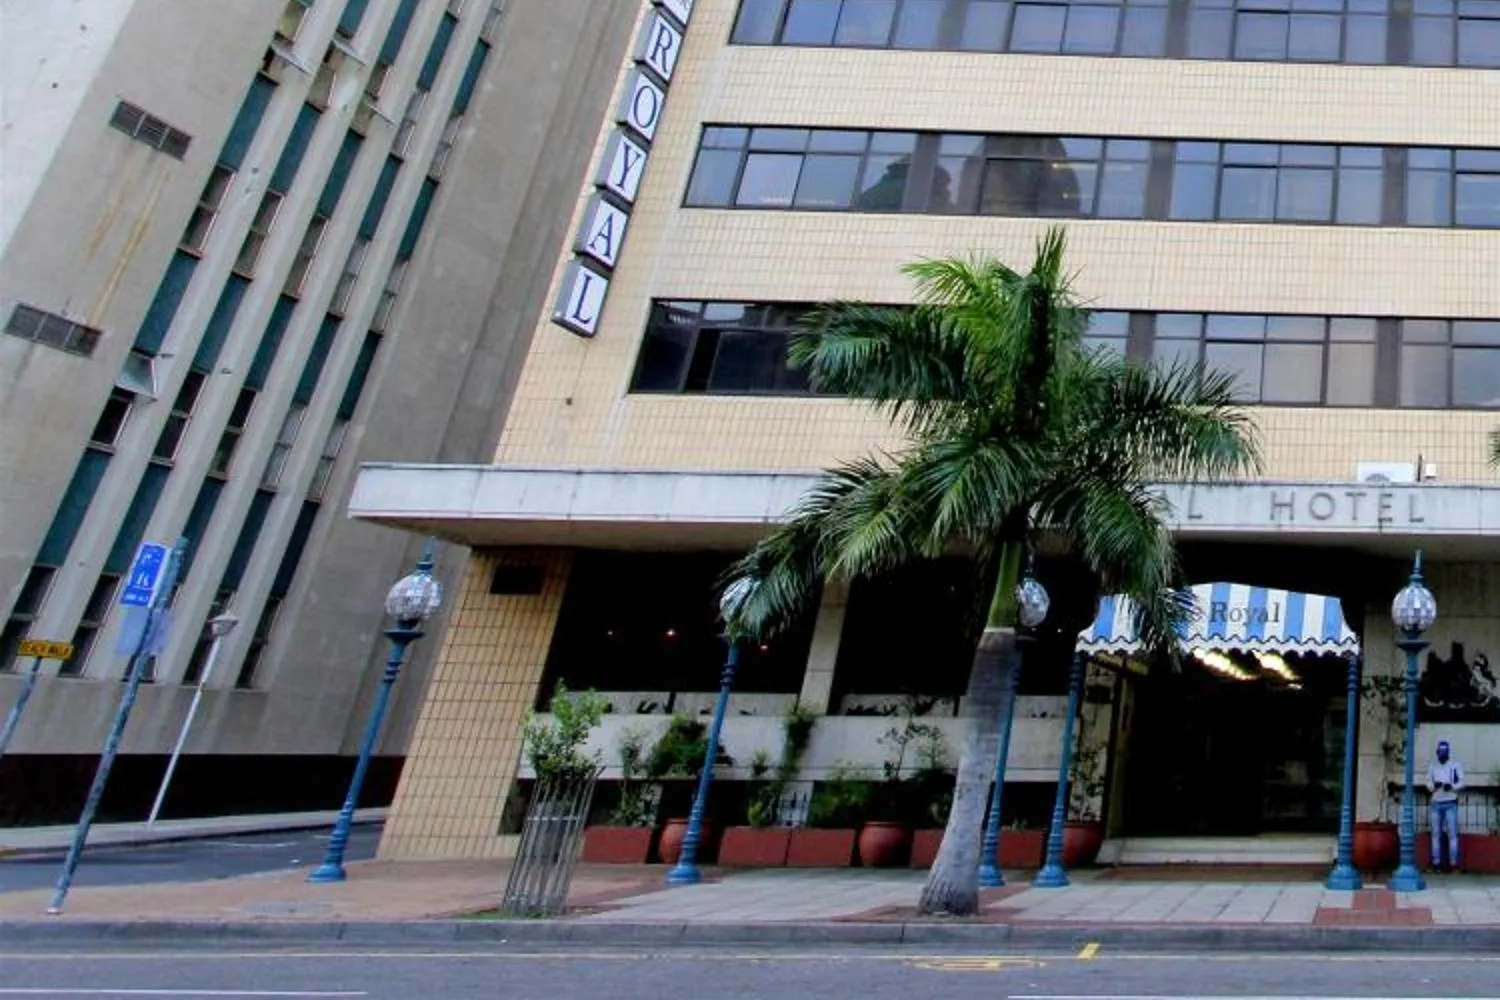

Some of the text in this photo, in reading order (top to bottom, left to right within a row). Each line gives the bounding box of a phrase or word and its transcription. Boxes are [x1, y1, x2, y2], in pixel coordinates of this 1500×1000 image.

[572, 27, 674, 325] ROYAL
[1270, 491, 1425, 523] HOTEL
[1210, 601, 1280, 627] Royal
